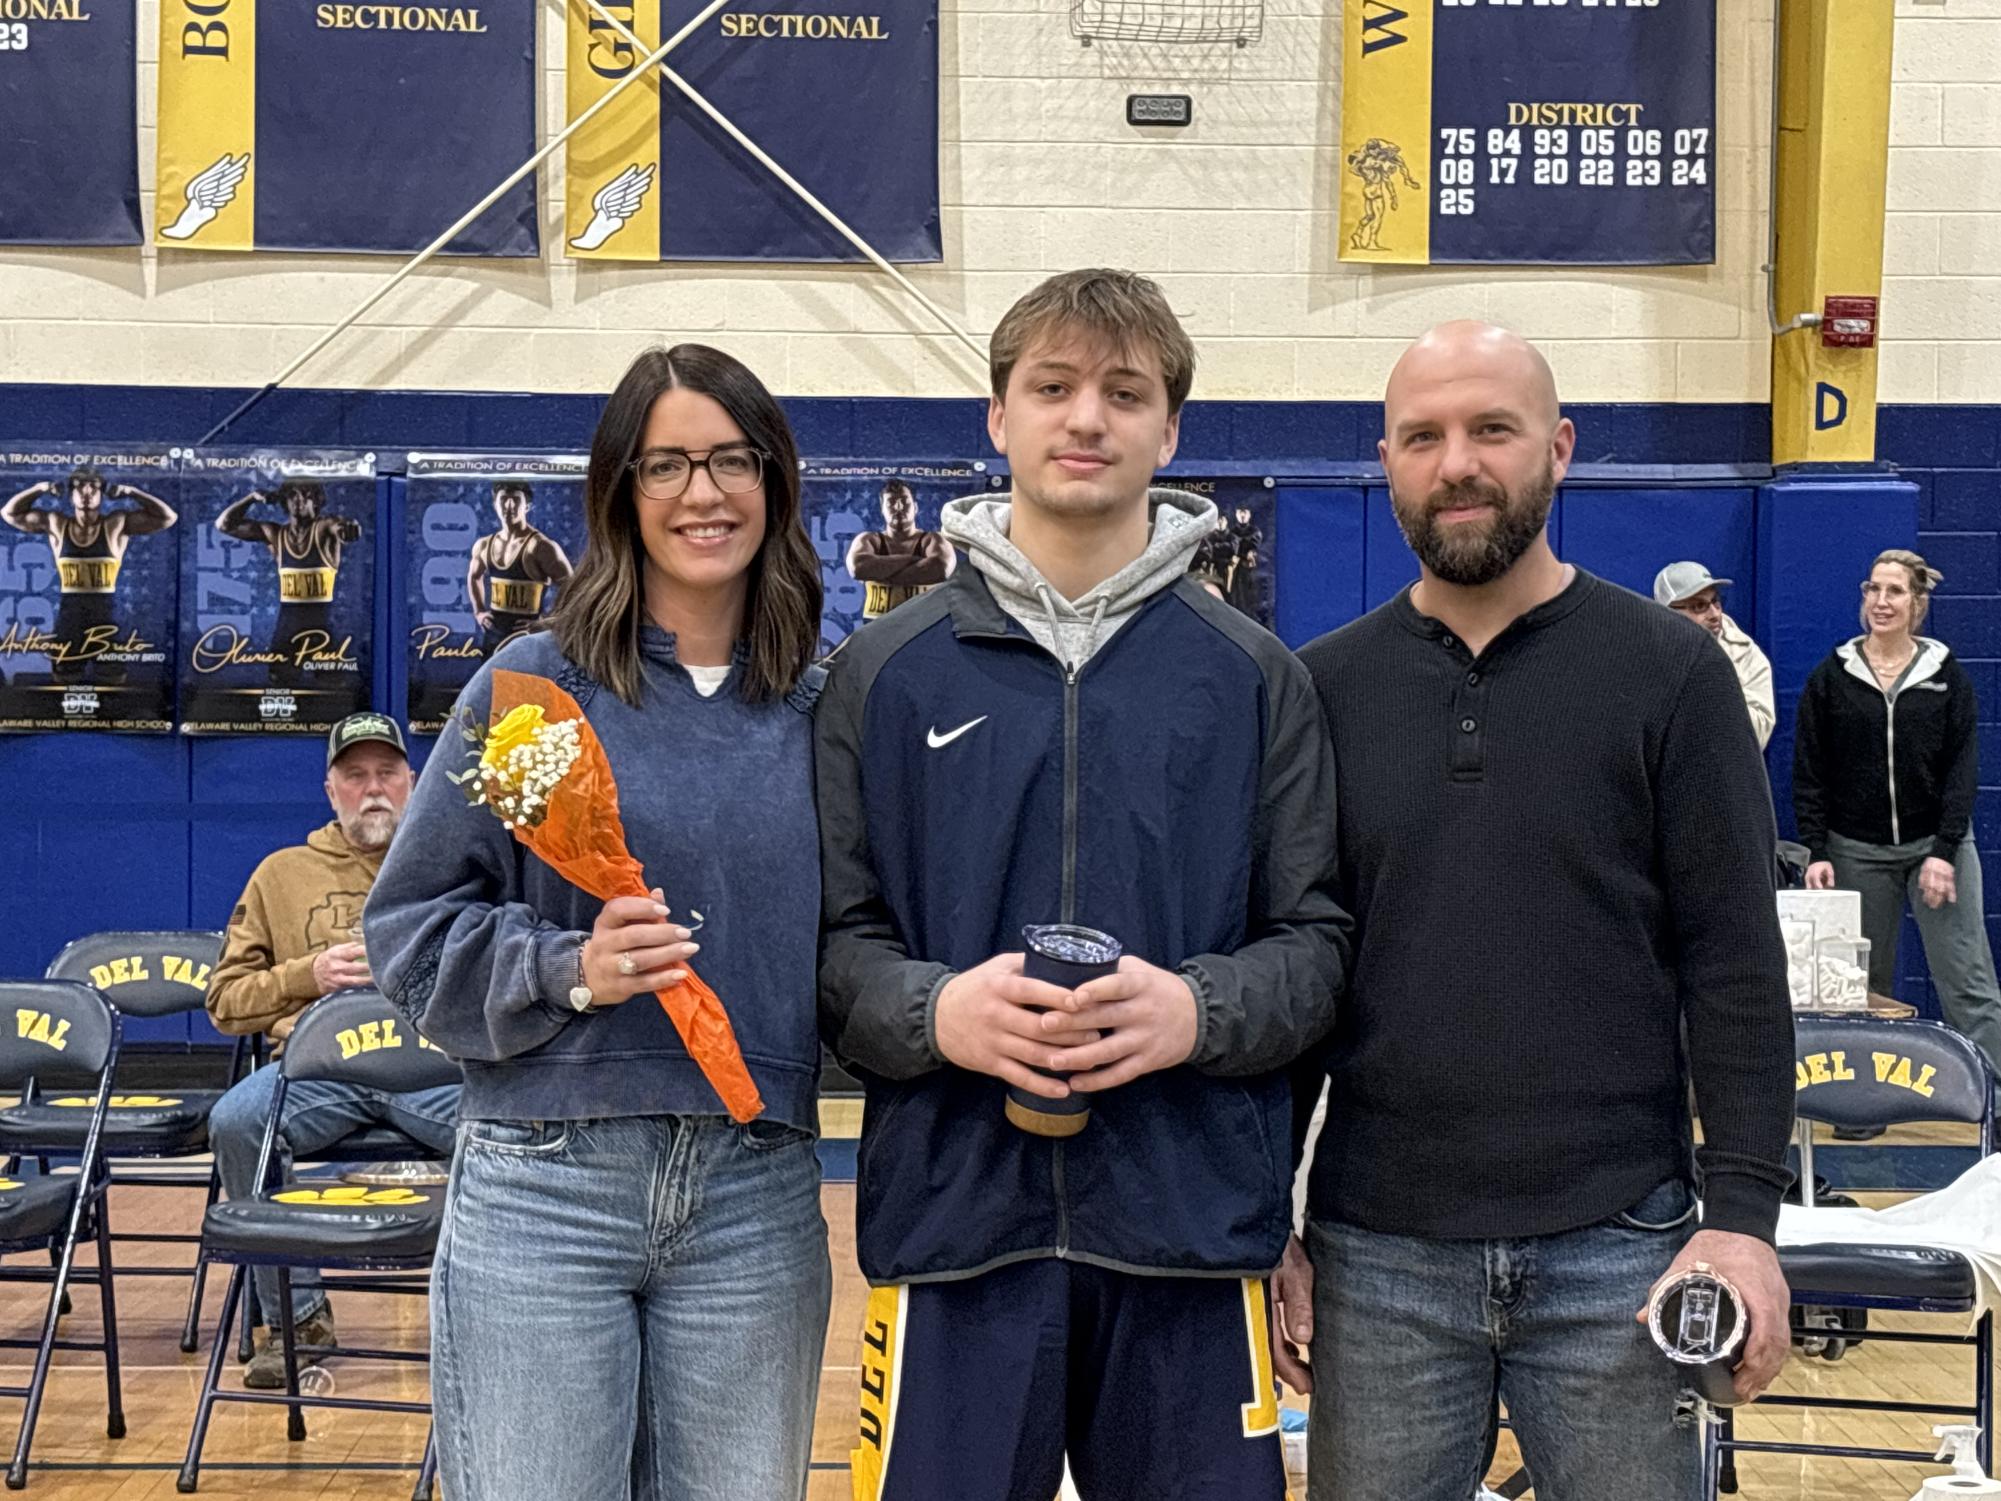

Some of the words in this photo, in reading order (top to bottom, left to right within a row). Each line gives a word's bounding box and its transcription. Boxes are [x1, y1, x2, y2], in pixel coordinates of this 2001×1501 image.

[316, 4, 488, 33] SECTIONAL
[720, 13, 889, 40] SECTIONAL
[1507, 103, 1644, 127] DISTRICT
[1440, 128, 1475, 154] 75
[1487, 129, 1521, 155] 84
[1534, 129, 1568, 155] 93
[1580, 129, 1615, 155] 05
[1627, 130, 1662, 155] 06
[1674, 129, 1709, 155] 07
[1440, 158, 1474, 184] 08
[1489, 158, 1516, 184] 17
[1534, 159, 1568, 184] 20
[1580, 159, 1614, 185] 22
[1626, 160, 1661, 185] 23
[1672, 159, 1707, 185] 24
[1440, 188, 1475, 215] 25
[1815, 382, 1848, 431] D
[9, 453, 71, 464] TRADITION
[73, 454, 91, 465] OF
[93, 455, 168, 467] EXCELLENCE
[206, 458, 267, 469] TRADITION
[291, 459, 361, 470] EXCELLENC
[433, 461, 493, 470] TRADITION
[495, 462, 512, 471] OF
[820, 467, 879, 475] TRADITION
[882, 467, 898, 475] OF
[901, 467, 973, 477] EXCELLENCE
[62, 563, 85, 588] DEL
[89, 563, 111, 588] VAL
[282, 573, 301, 597] DEL
[305, 573, 327, 597] VAL
[291, 629, 357, 666] Paul
[411, 624, 483, 660] Paulo
[303, 662, 335, 671] OLIVIER
[337, 662, 359, 671] PAUL
[0, 719, 33, 728] AWARE
[36, 719, 66, 728] VALLEY
[68, 719, 111, 729] REGIONAL
[135, 720, 168, 729] SCHOO
[233, 722, 263, 731] VALLEY
[265, 722, 308, 732] REGIONAL
[310, 723, 332, 732] HIGH
[89, 956, 149, 991] DEL
[162, 955, 212, 992] VAL
[16, 1008, 72, 1051] VAL
[335, 1019, 402, 1061] DEL
[1872, 1051, 1937, 1099] VAL
[860, 1319, 888, 1452] DEL
